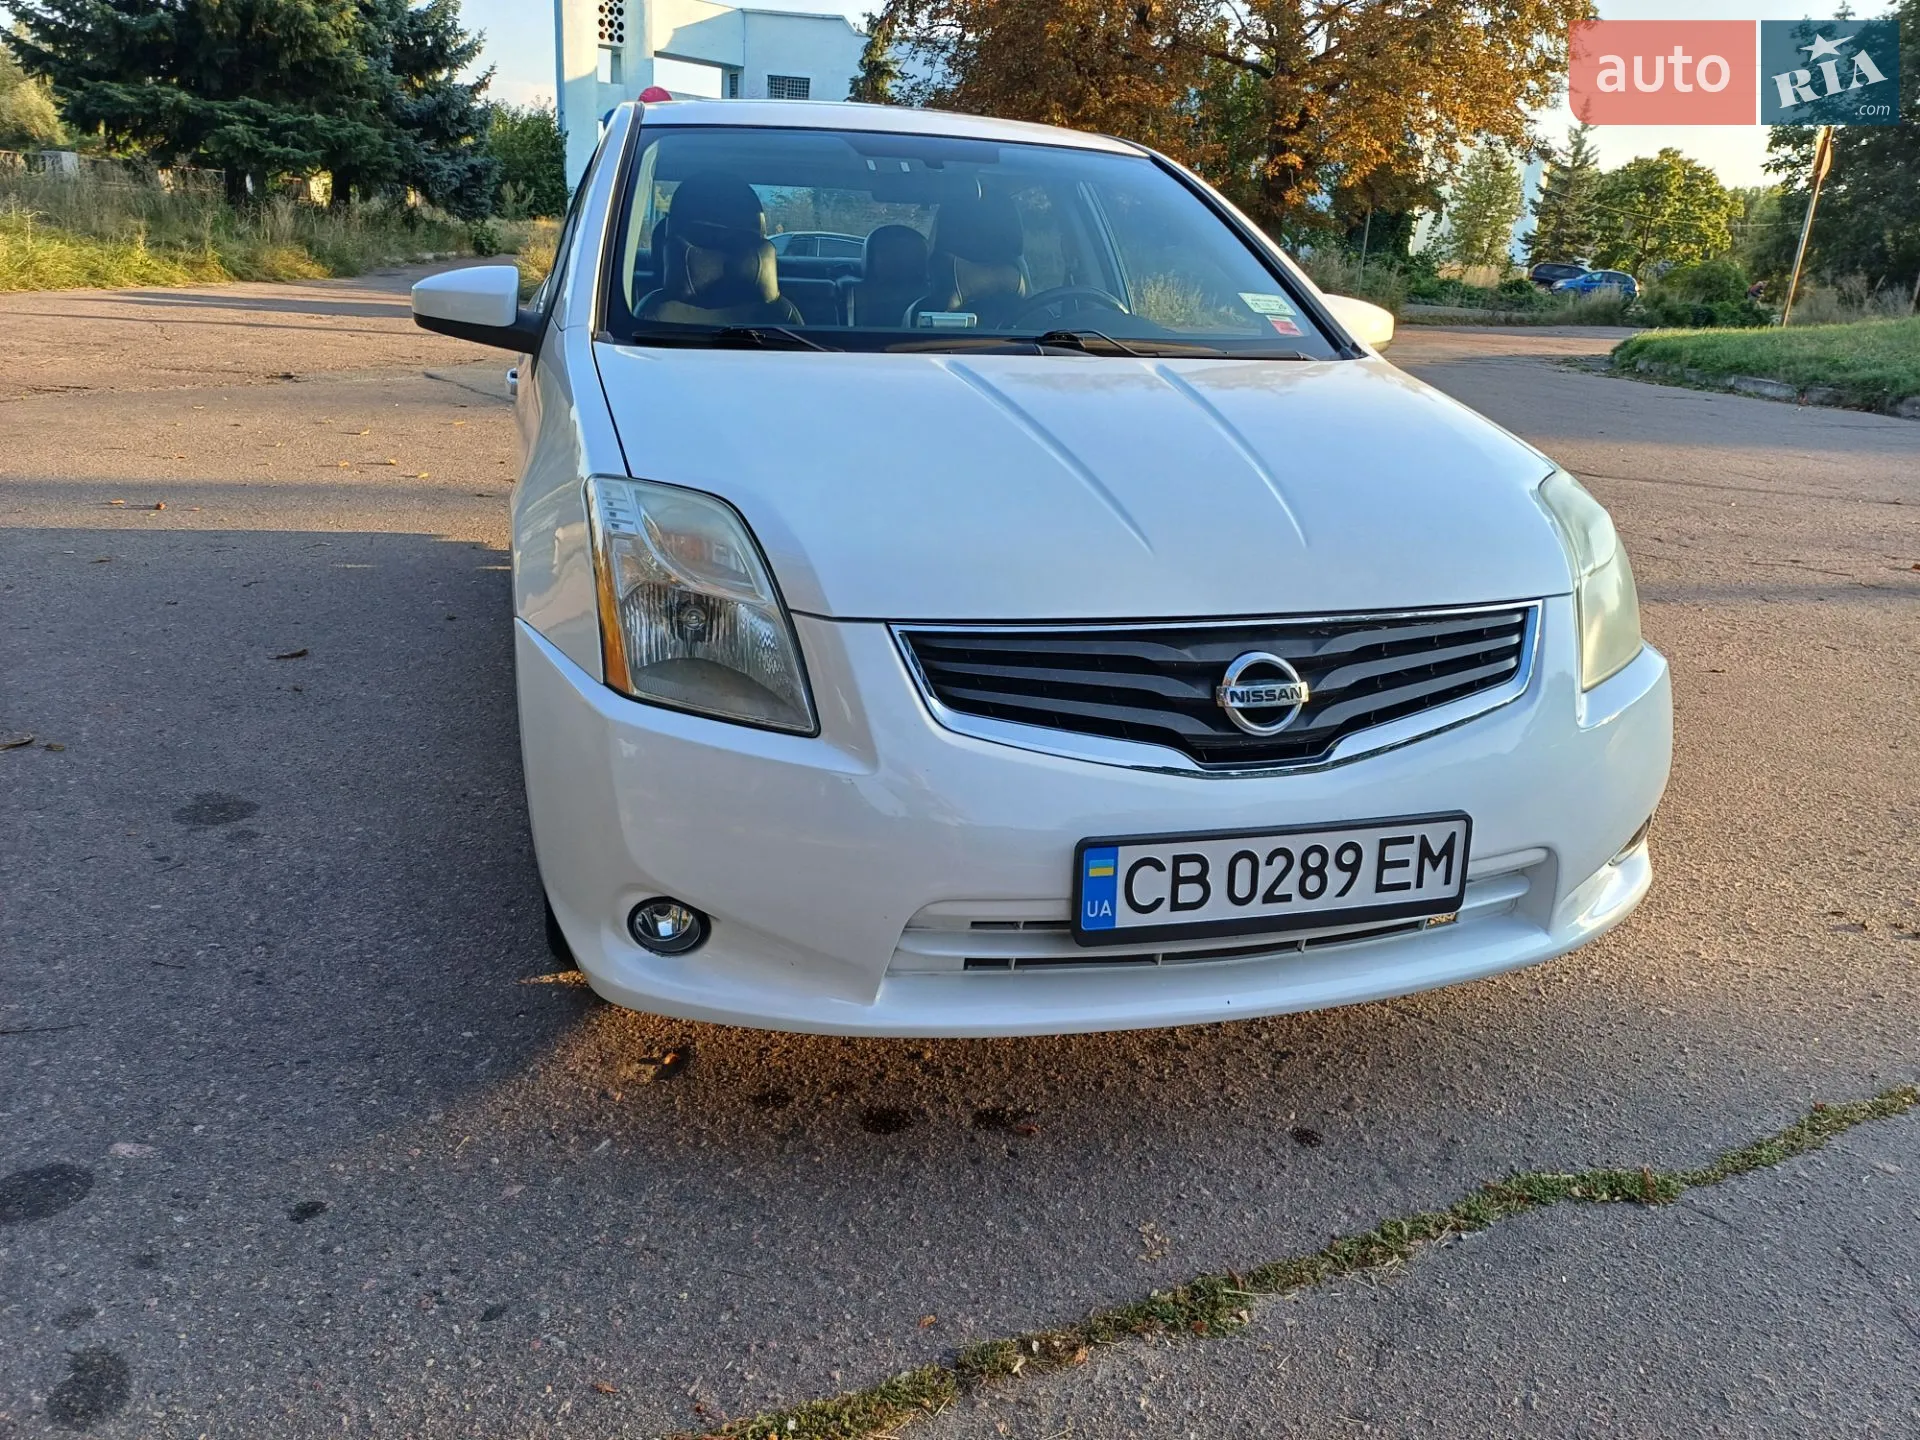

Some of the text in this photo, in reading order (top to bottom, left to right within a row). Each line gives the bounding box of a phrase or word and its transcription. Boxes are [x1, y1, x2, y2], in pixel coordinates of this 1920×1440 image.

[1229, 687, 1303, 703] NISSAN
[1124, 831, 1457, 915] CB 0289 EM
[1087, 900, 1113, 919] UA
